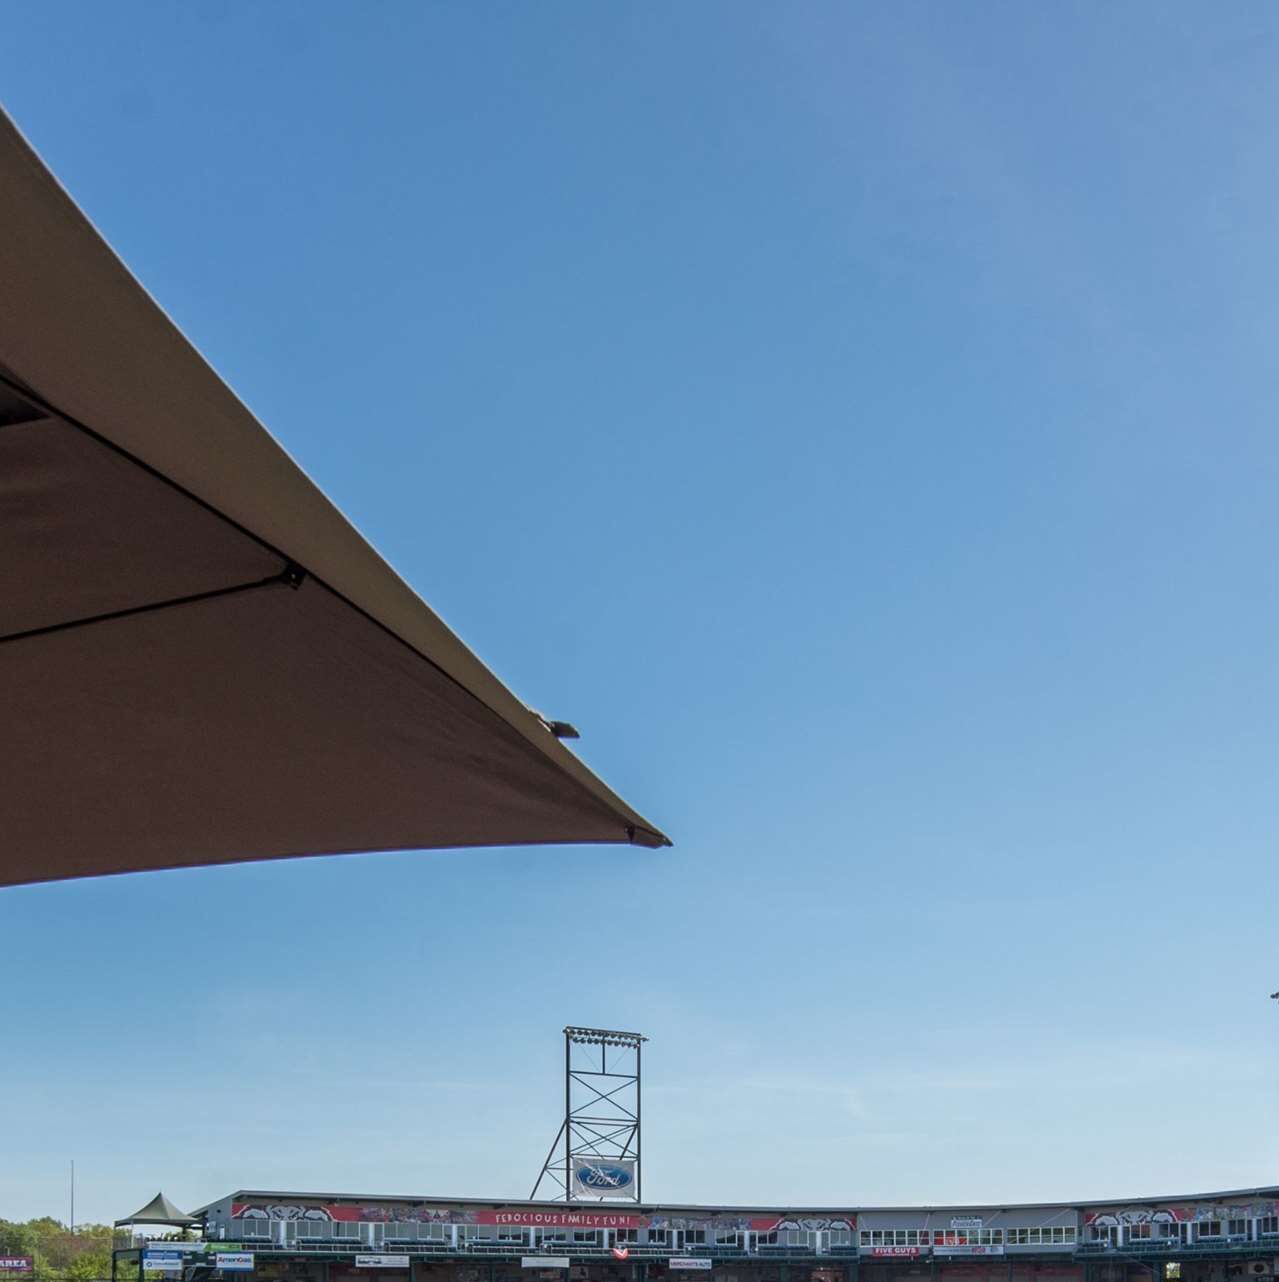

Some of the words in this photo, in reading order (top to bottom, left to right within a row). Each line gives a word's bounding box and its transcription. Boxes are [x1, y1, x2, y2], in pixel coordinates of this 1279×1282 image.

[586, 1169, 620, 1186] Ford
[495, 1213, 558, 1224] FEROCIOUS
[561, 1214, 600, 1225] FAMILY
[603, 1215, 631, 1225] FUN!
